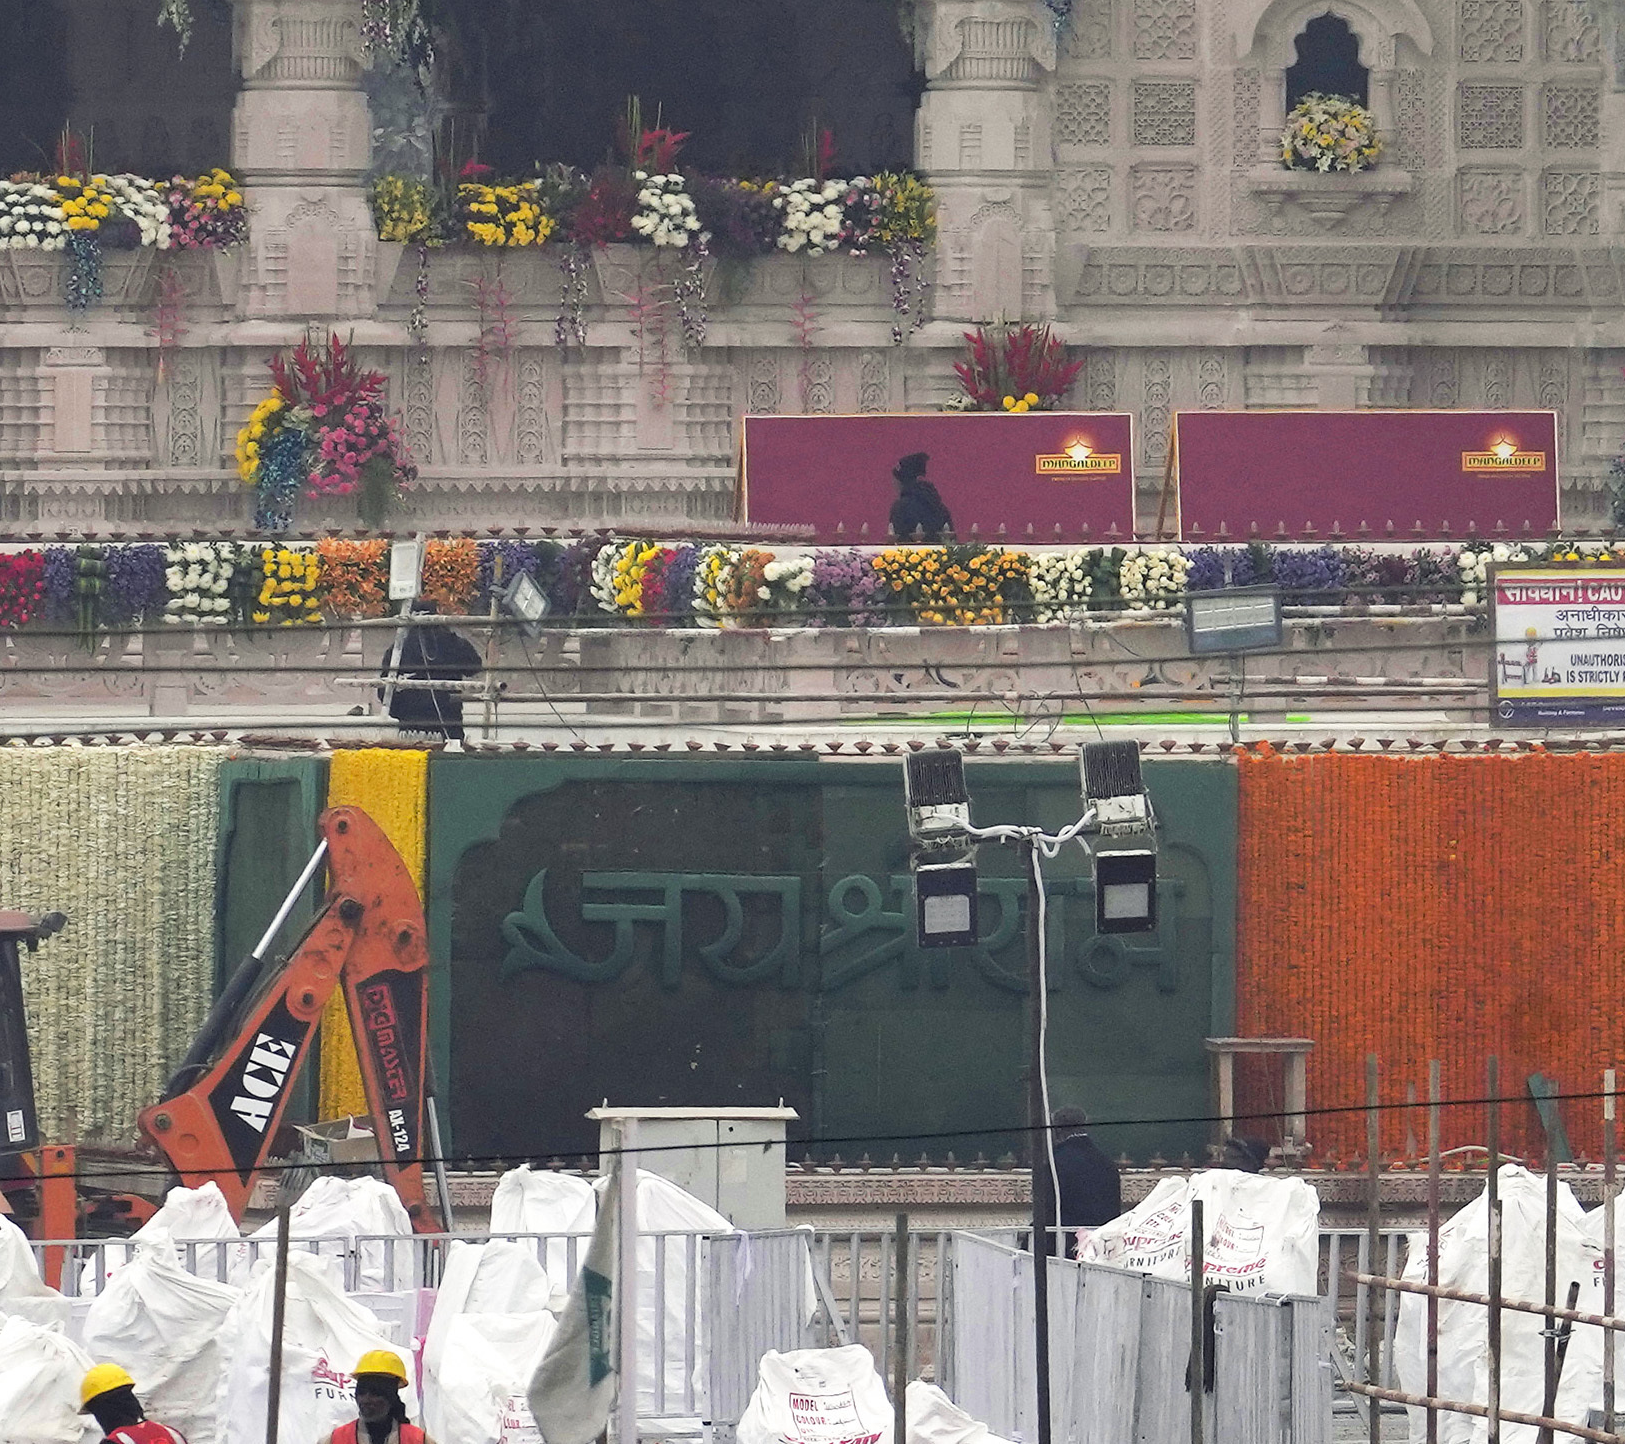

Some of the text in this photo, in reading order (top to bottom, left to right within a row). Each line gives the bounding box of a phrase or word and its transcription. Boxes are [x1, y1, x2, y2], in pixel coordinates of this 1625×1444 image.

[1042, 459, 1116, 469] MANGALDEEP
[1468, 456, 1541, 466] MANGALDEEP
[1566, 670, 1576, 683] IS
[1578, 670, 1620, 683] STRICTLY
[230, 1032, 296, 1134] ACE
[388, 1109, 411, 1153] AX-124
[792, 1398, 819, 1412] MODEL
